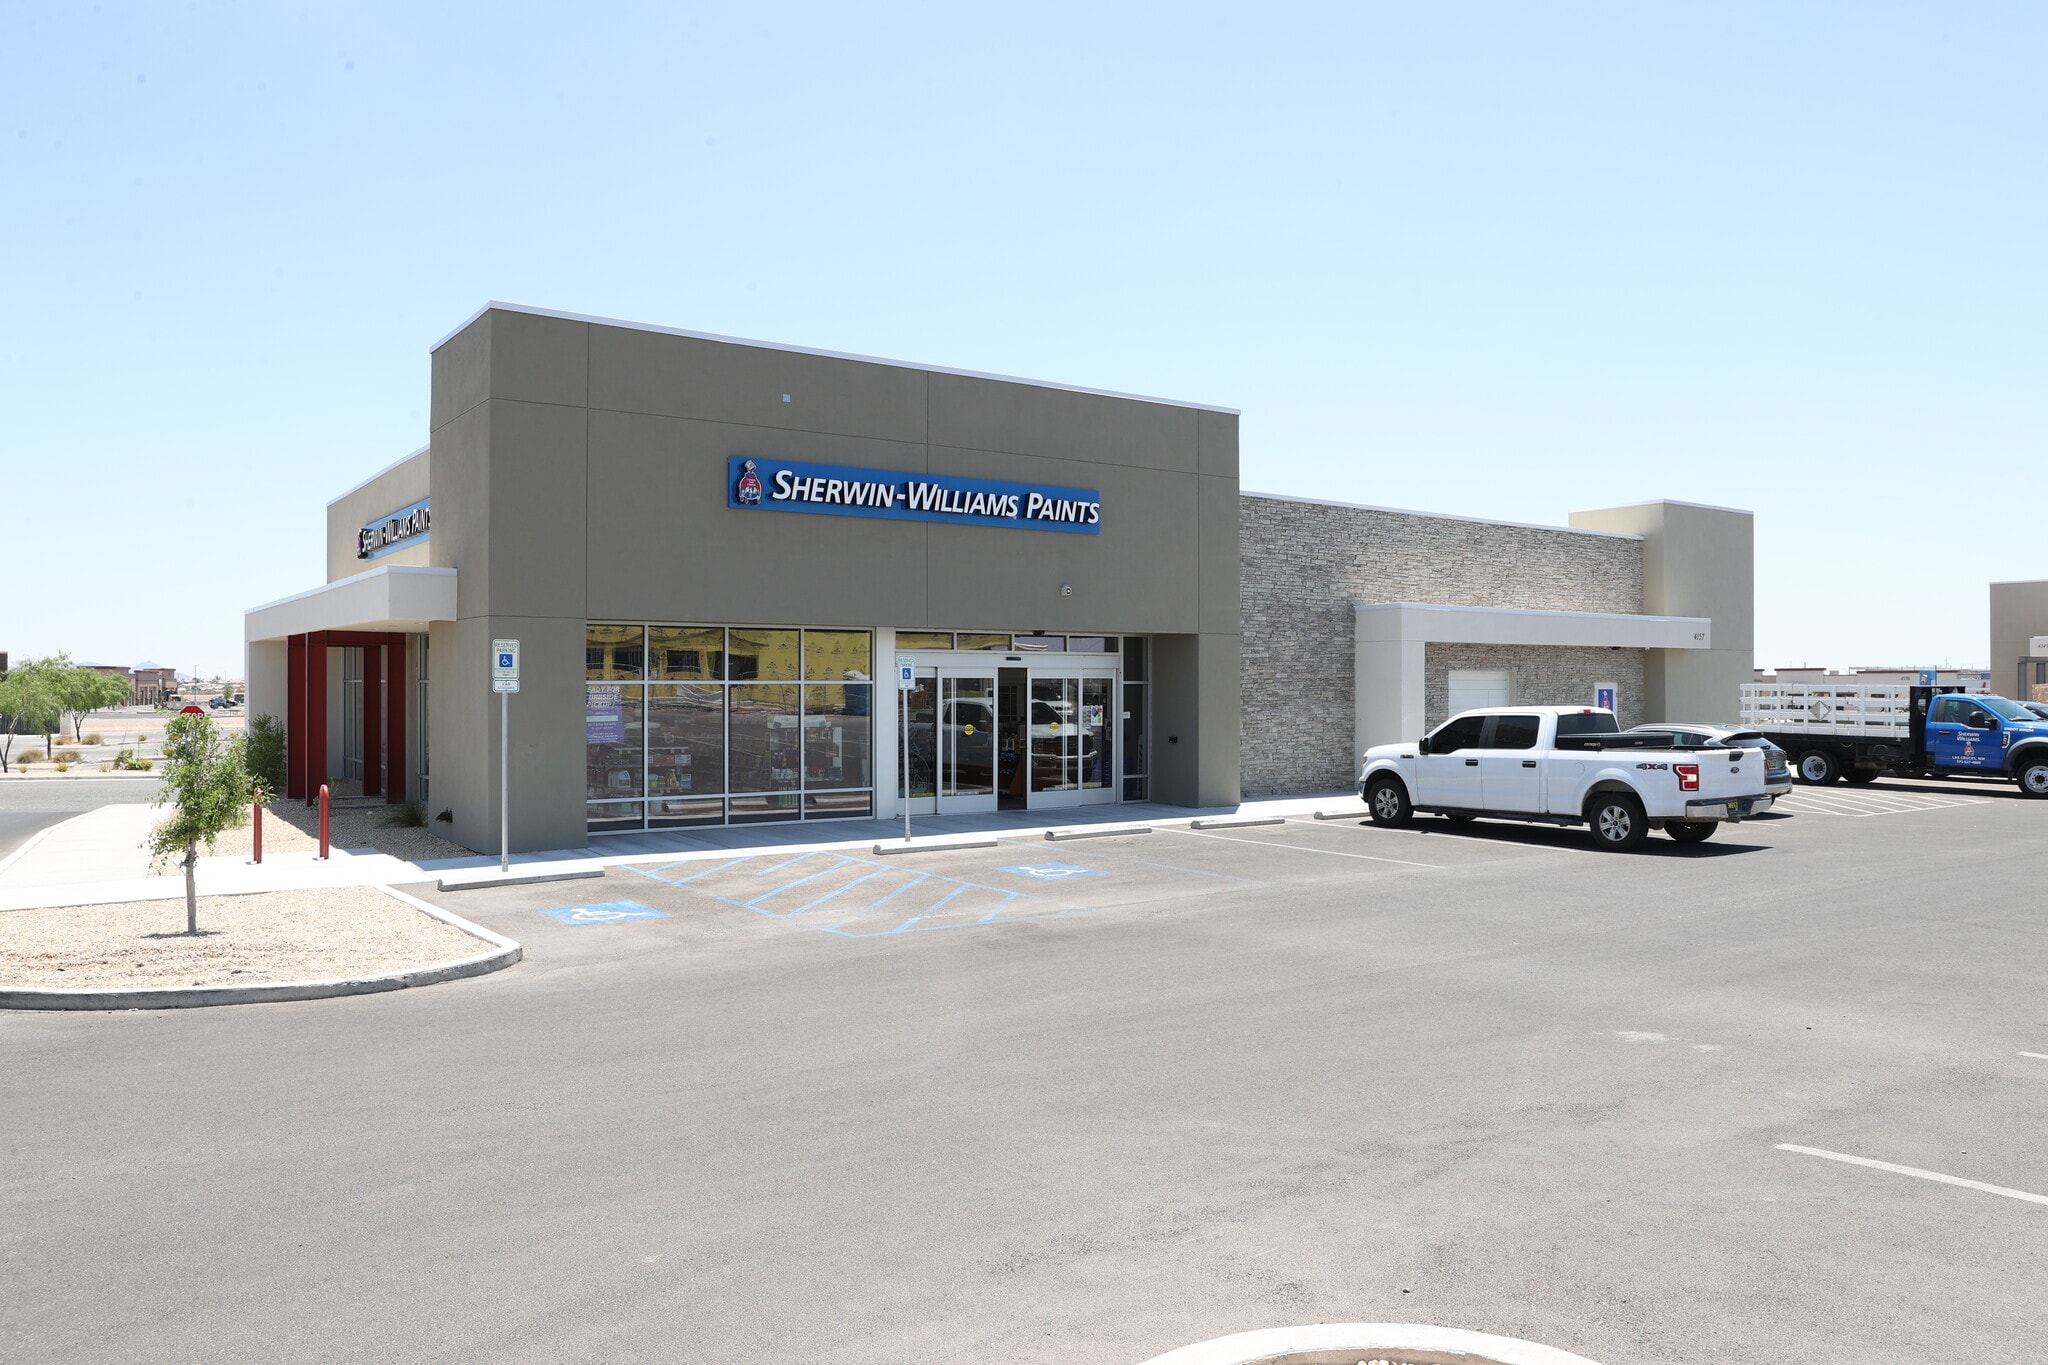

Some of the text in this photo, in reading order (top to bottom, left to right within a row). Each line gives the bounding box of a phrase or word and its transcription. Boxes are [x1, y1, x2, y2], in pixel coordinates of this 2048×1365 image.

[772, 469, 1100, 524] SHERWIN-WILLIAMS PAINTS
[588, 693, 619, 701] URBSIDE
